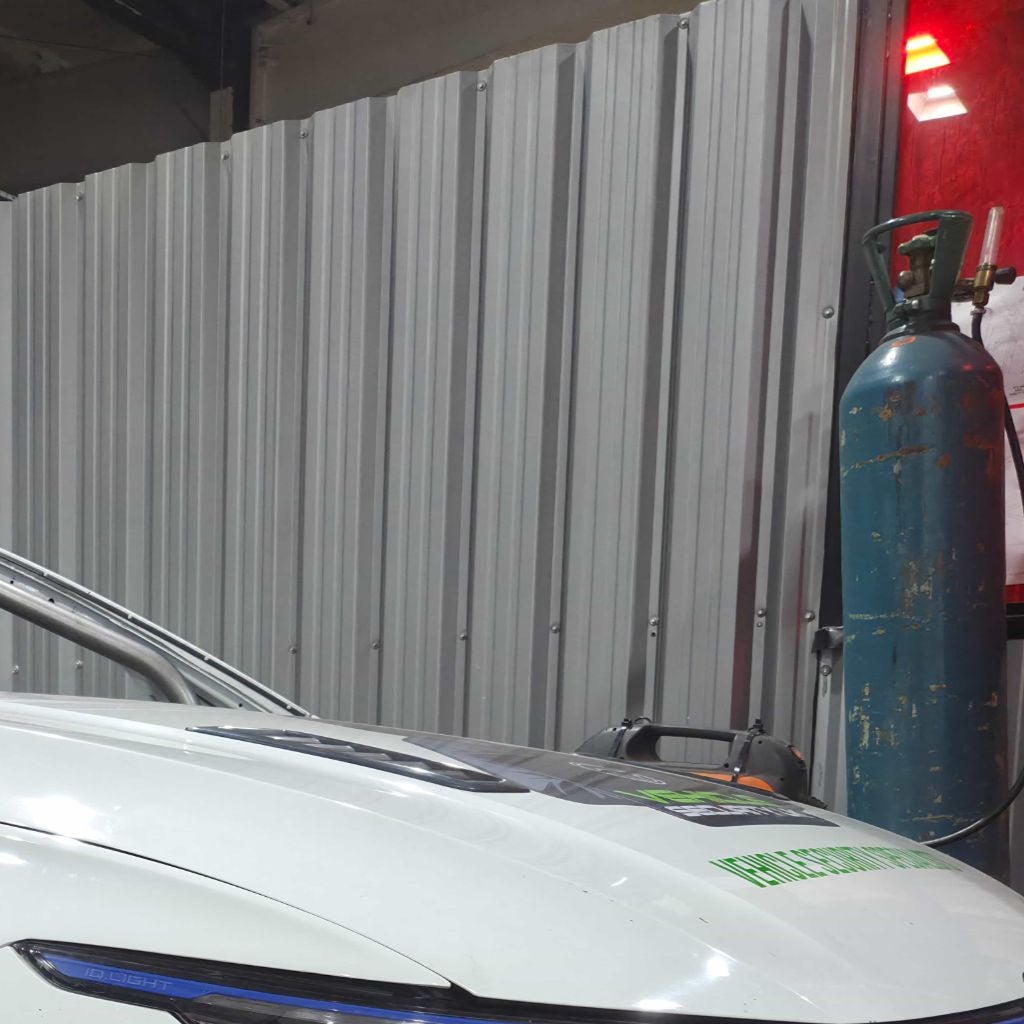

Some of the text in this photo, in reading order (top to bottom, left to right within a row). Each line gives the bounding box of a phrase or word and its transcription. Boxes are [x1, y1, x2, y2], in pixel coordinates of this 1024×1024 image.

[708, 849, 830, 888] VEHICLE
[784, 846, 898, 878] SECURITY
[84, 967, 173, 990] IQ.LIGHT
